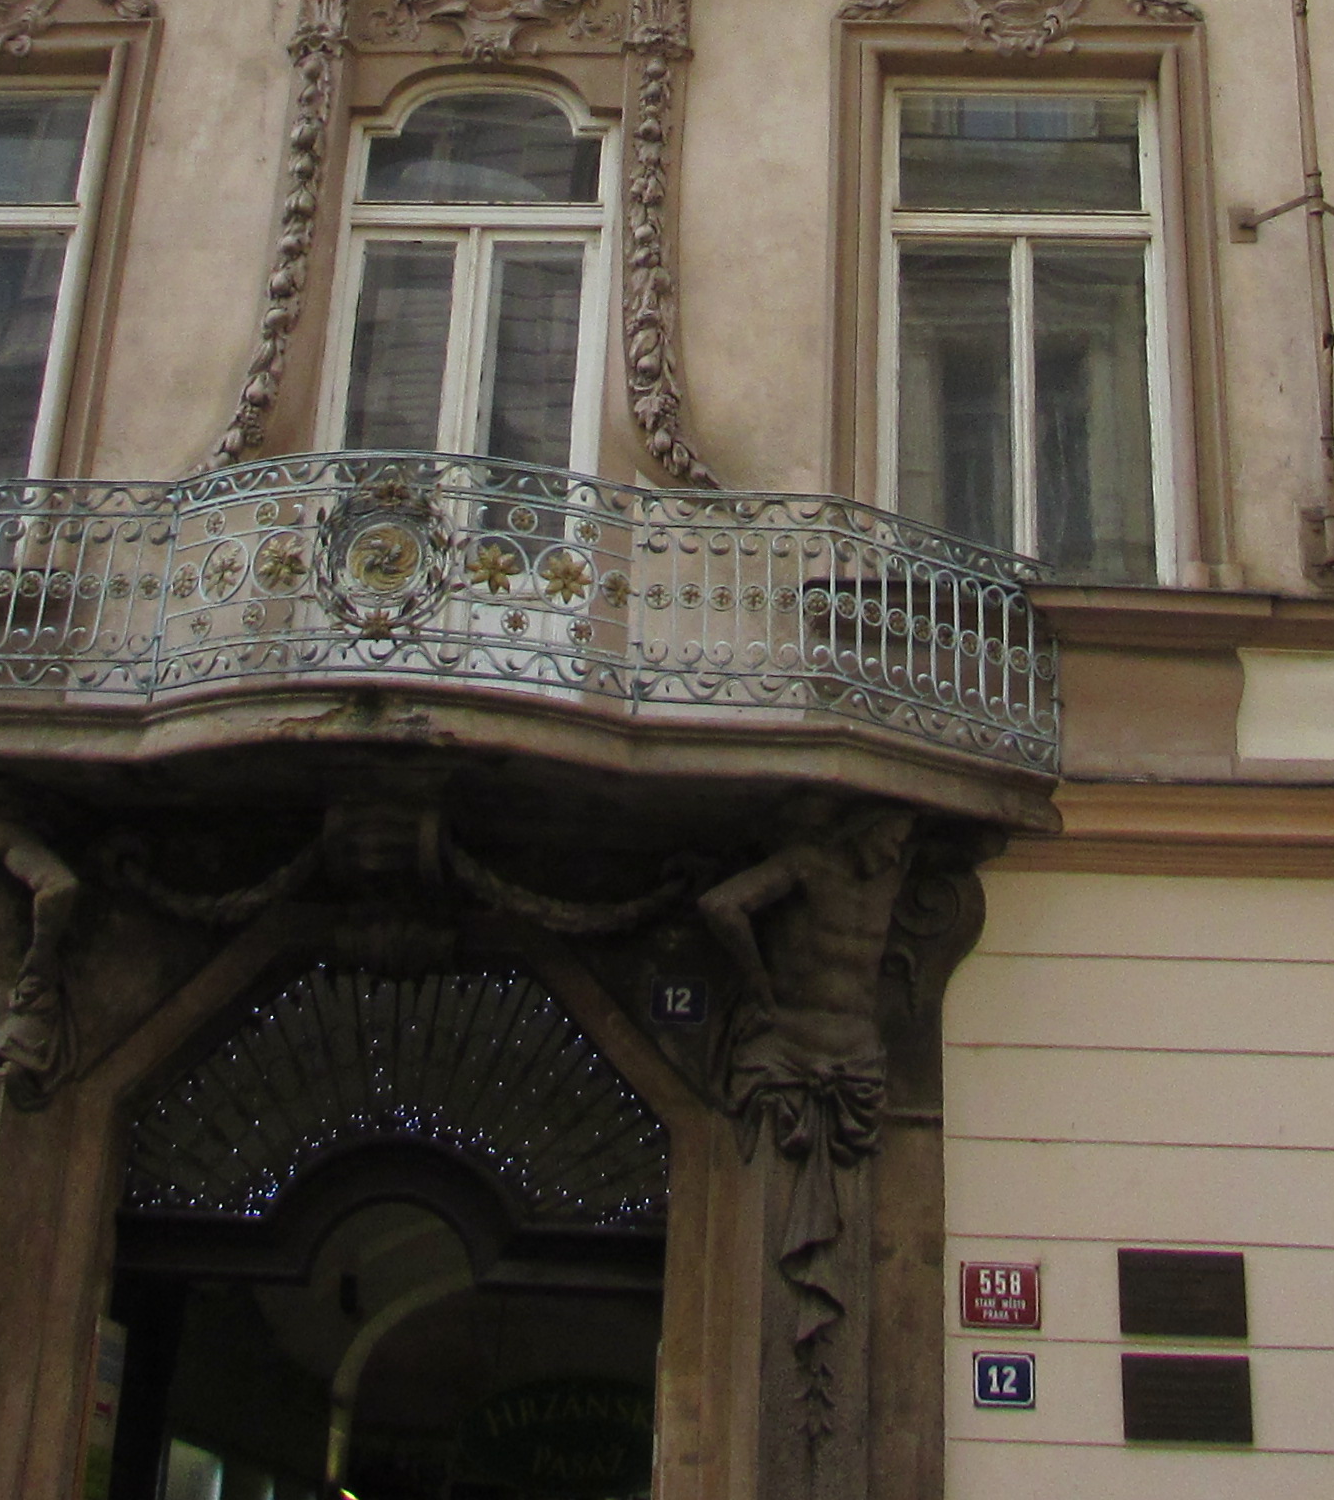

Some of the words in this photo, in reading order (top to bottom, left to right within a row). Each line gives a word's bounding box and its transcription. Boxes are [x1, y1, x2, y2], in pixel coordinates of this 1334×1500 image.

[665, 986, 692, 1013] 12
[979, 1269, 1021, 1296] 558
[987, 1364, 1017, 1393] 12
